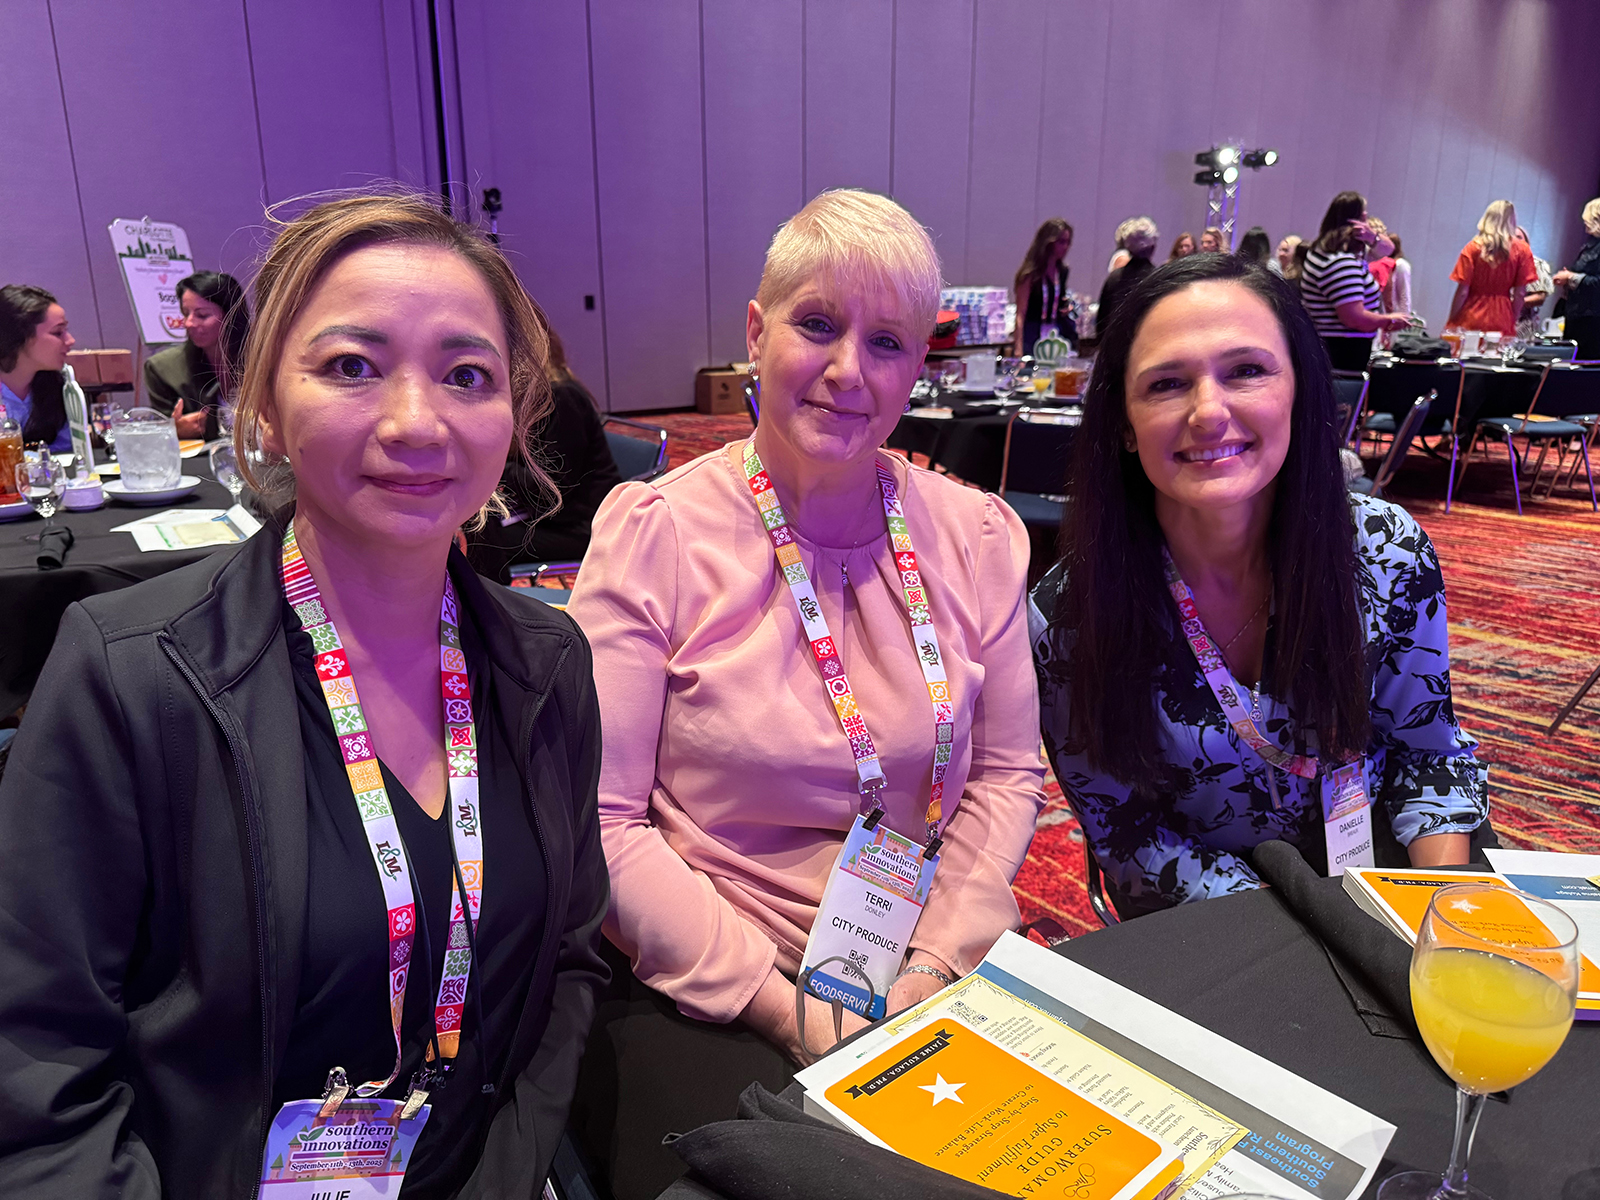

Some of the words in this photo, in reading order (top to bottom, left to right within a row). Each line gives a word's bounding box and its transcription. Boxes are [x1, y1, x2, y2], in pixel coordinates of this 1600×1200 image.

[455, 798, 478, 837] L&M
[1339, 815, 1364, 833] DANIELLE
[376, 840, 402, 881] L&M
[880, 848, 919, 873] southern
[1335, 851, 1349, 864] CITY
[1348, 839, 1370, 859] PRODUCE
[866, 853, 916, 881] innovations
[864, 904, 886, 919] DONLEY
[865, 891, 893, 912] TERRI
[832, 916, 856, 933] CITY
[855, 926, 899, 953] PRODUCE
[919, 1039, 942, 1056] JAIME
[886, 1055, 919, 1075] KULAGA,
[866, 1076, 887, 1089] PH.D.
[1024, 1083, 1034, 1091] to
[1001, 1090, 1026, 1106] Create
[964, 1107, 1004, 1133] Work-Life
[989, 1096, 1039, 1130] Step-by-Step
[1054, 1109, 1068, 1118] to
[1172, 1114, 1185, 1125] Local
[326, 1123, 394, 1136] southern
[1029, 1117, 1059, 1141] Super
[302, 1137, 389, 1151] innovations
[935, 1133, 966, 1155] Balance
[954, 1129, 993, 1158] Strategies
[1181, 1131, 1208, 1153] Southe
[1275, 1131, 1335, 1171] Program
[290, 1162, 328, 1172] September
[365, 1159, 383, 1167] 2025
[976, 1138, 1033, 1182] Fulfillment
[1016, 1137, 1062, 1173] GUIDE
[1249, 1141, 1319, 1189] Southeast
[1264, 1140, 1327, 1180] Southern
